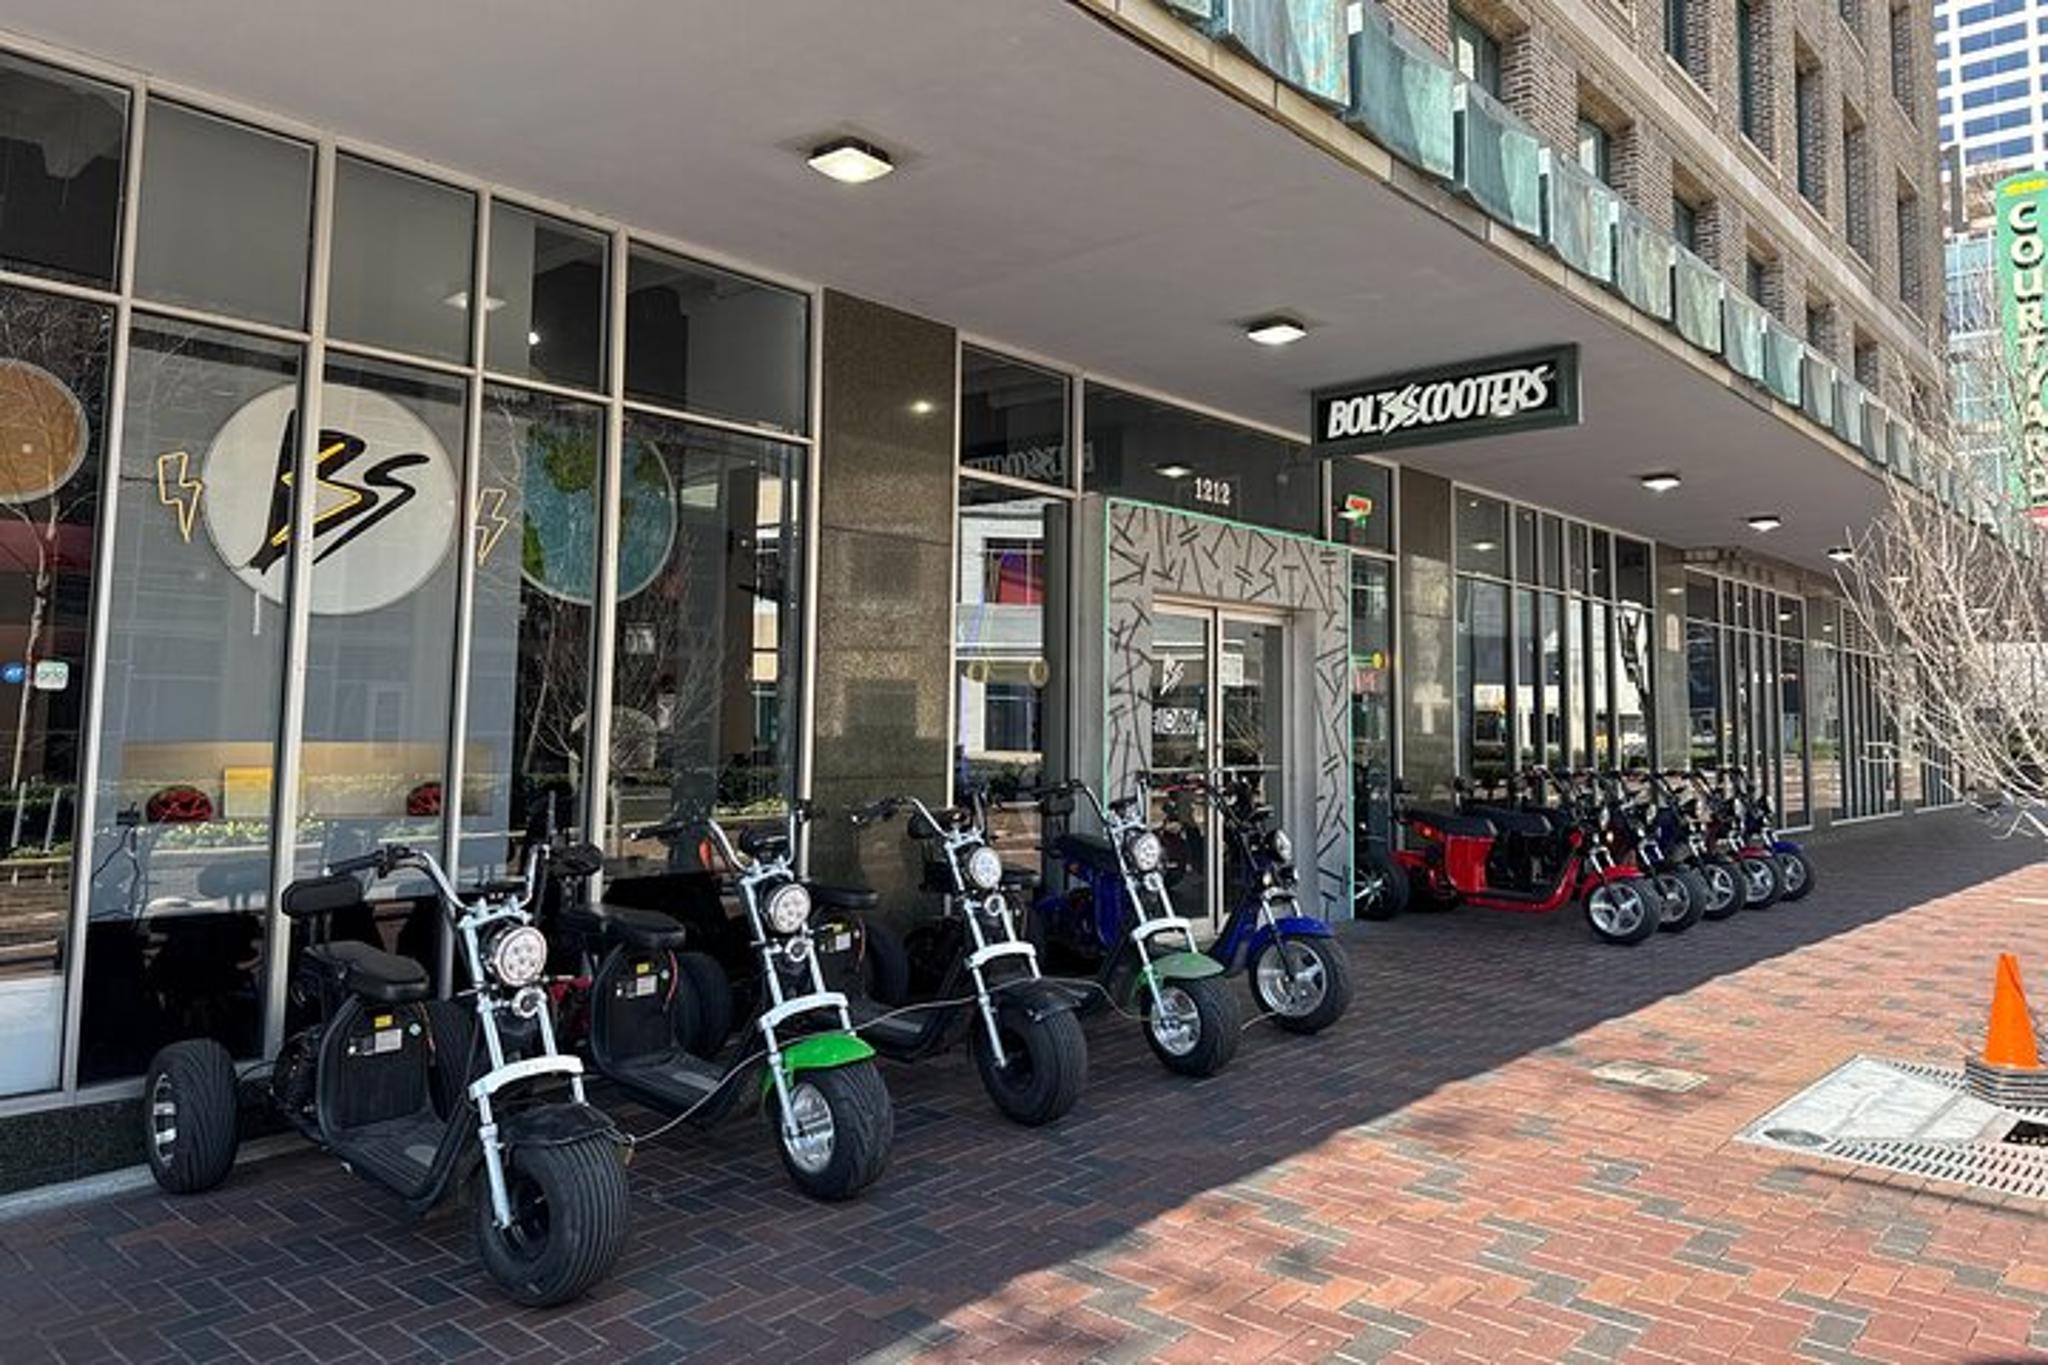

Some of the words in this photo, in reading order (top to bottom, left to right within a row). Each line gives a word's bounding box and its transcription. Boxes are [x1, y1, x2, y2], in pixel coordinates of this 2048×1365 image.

[1327, 390, 1396, 438] BOLT
[1400, 365, 1549, 427] SCOOTERS
[1194, 477, 1230, 505] 1212
